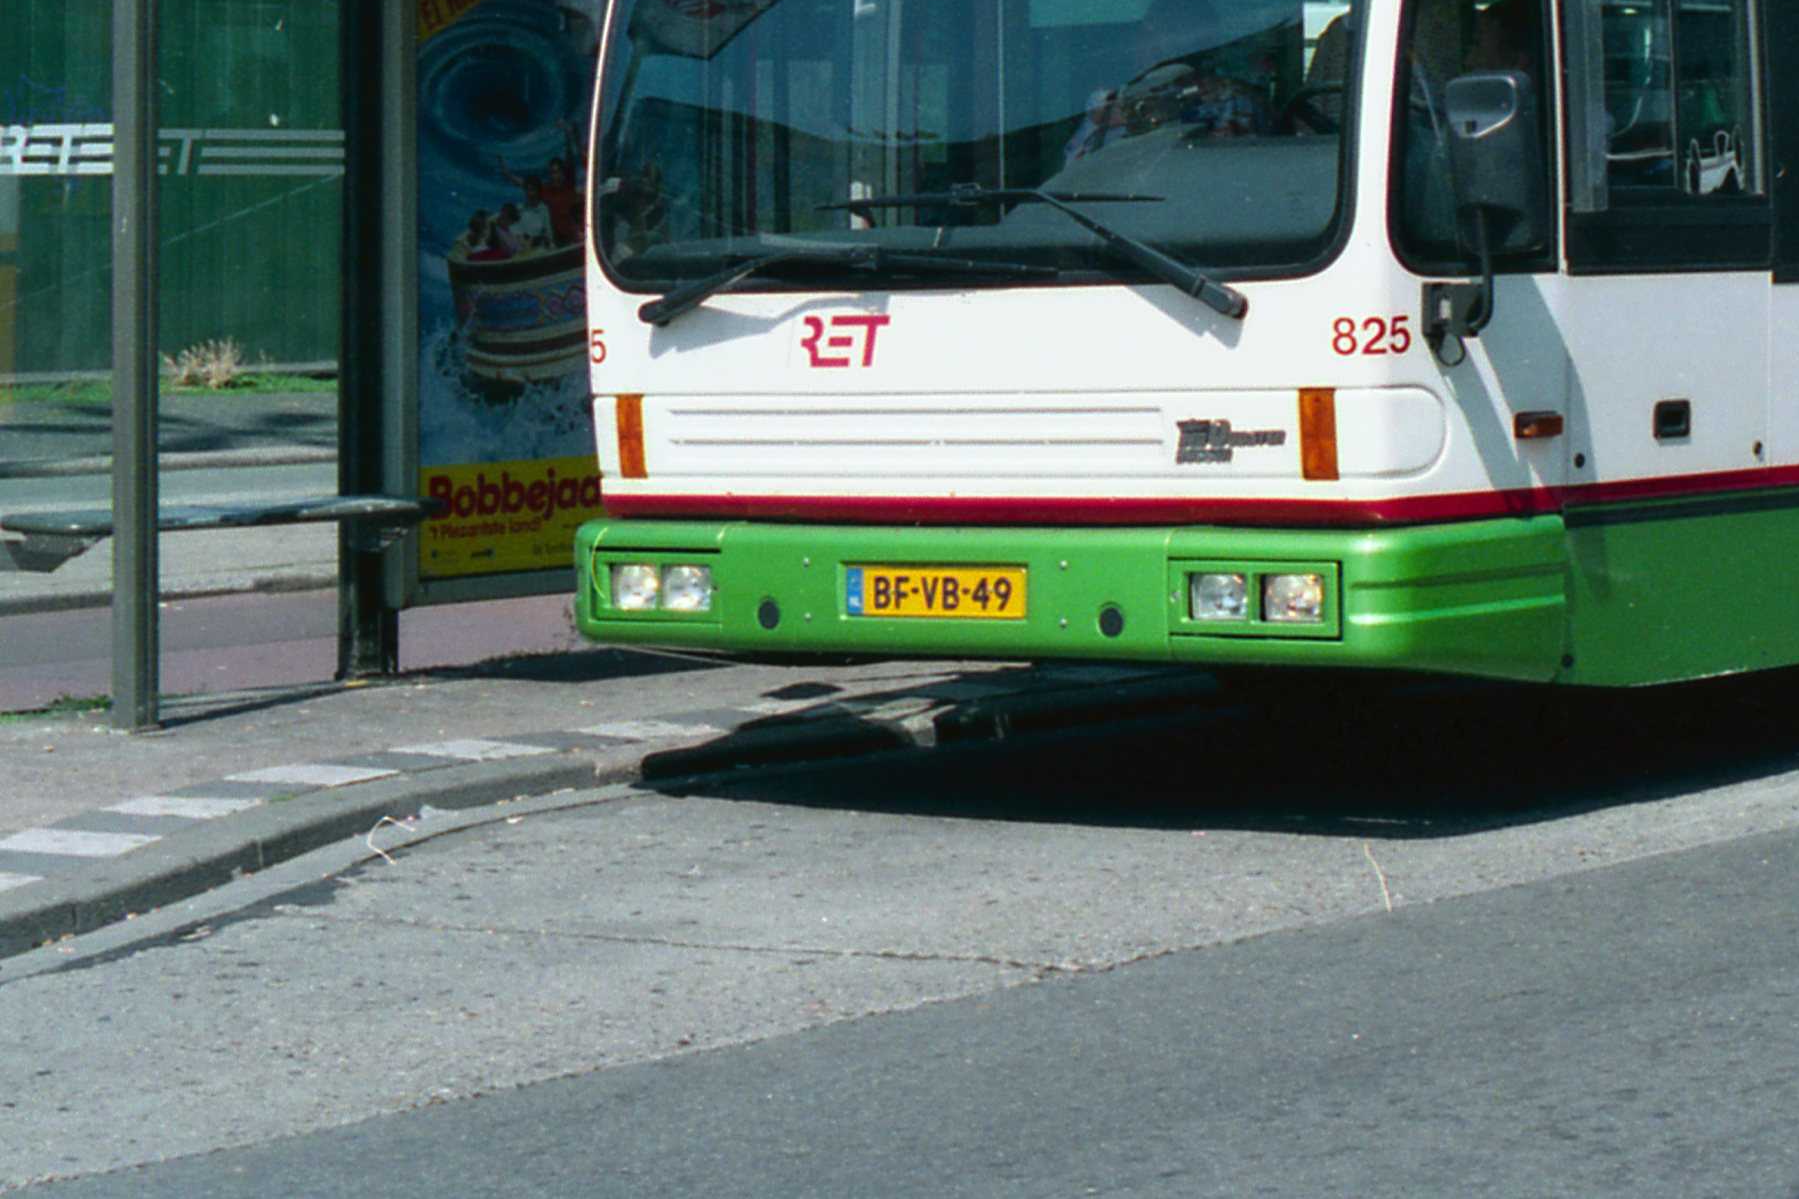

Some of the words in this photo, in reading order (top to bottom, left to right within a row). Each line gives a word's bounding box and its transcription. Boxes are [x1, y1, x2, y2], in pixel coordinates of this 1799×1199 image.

[801, 315, 890, 367] RET
[1332, 315, 1411, 355] 825
[873, 576, 1012, 611] BF-VB-49
